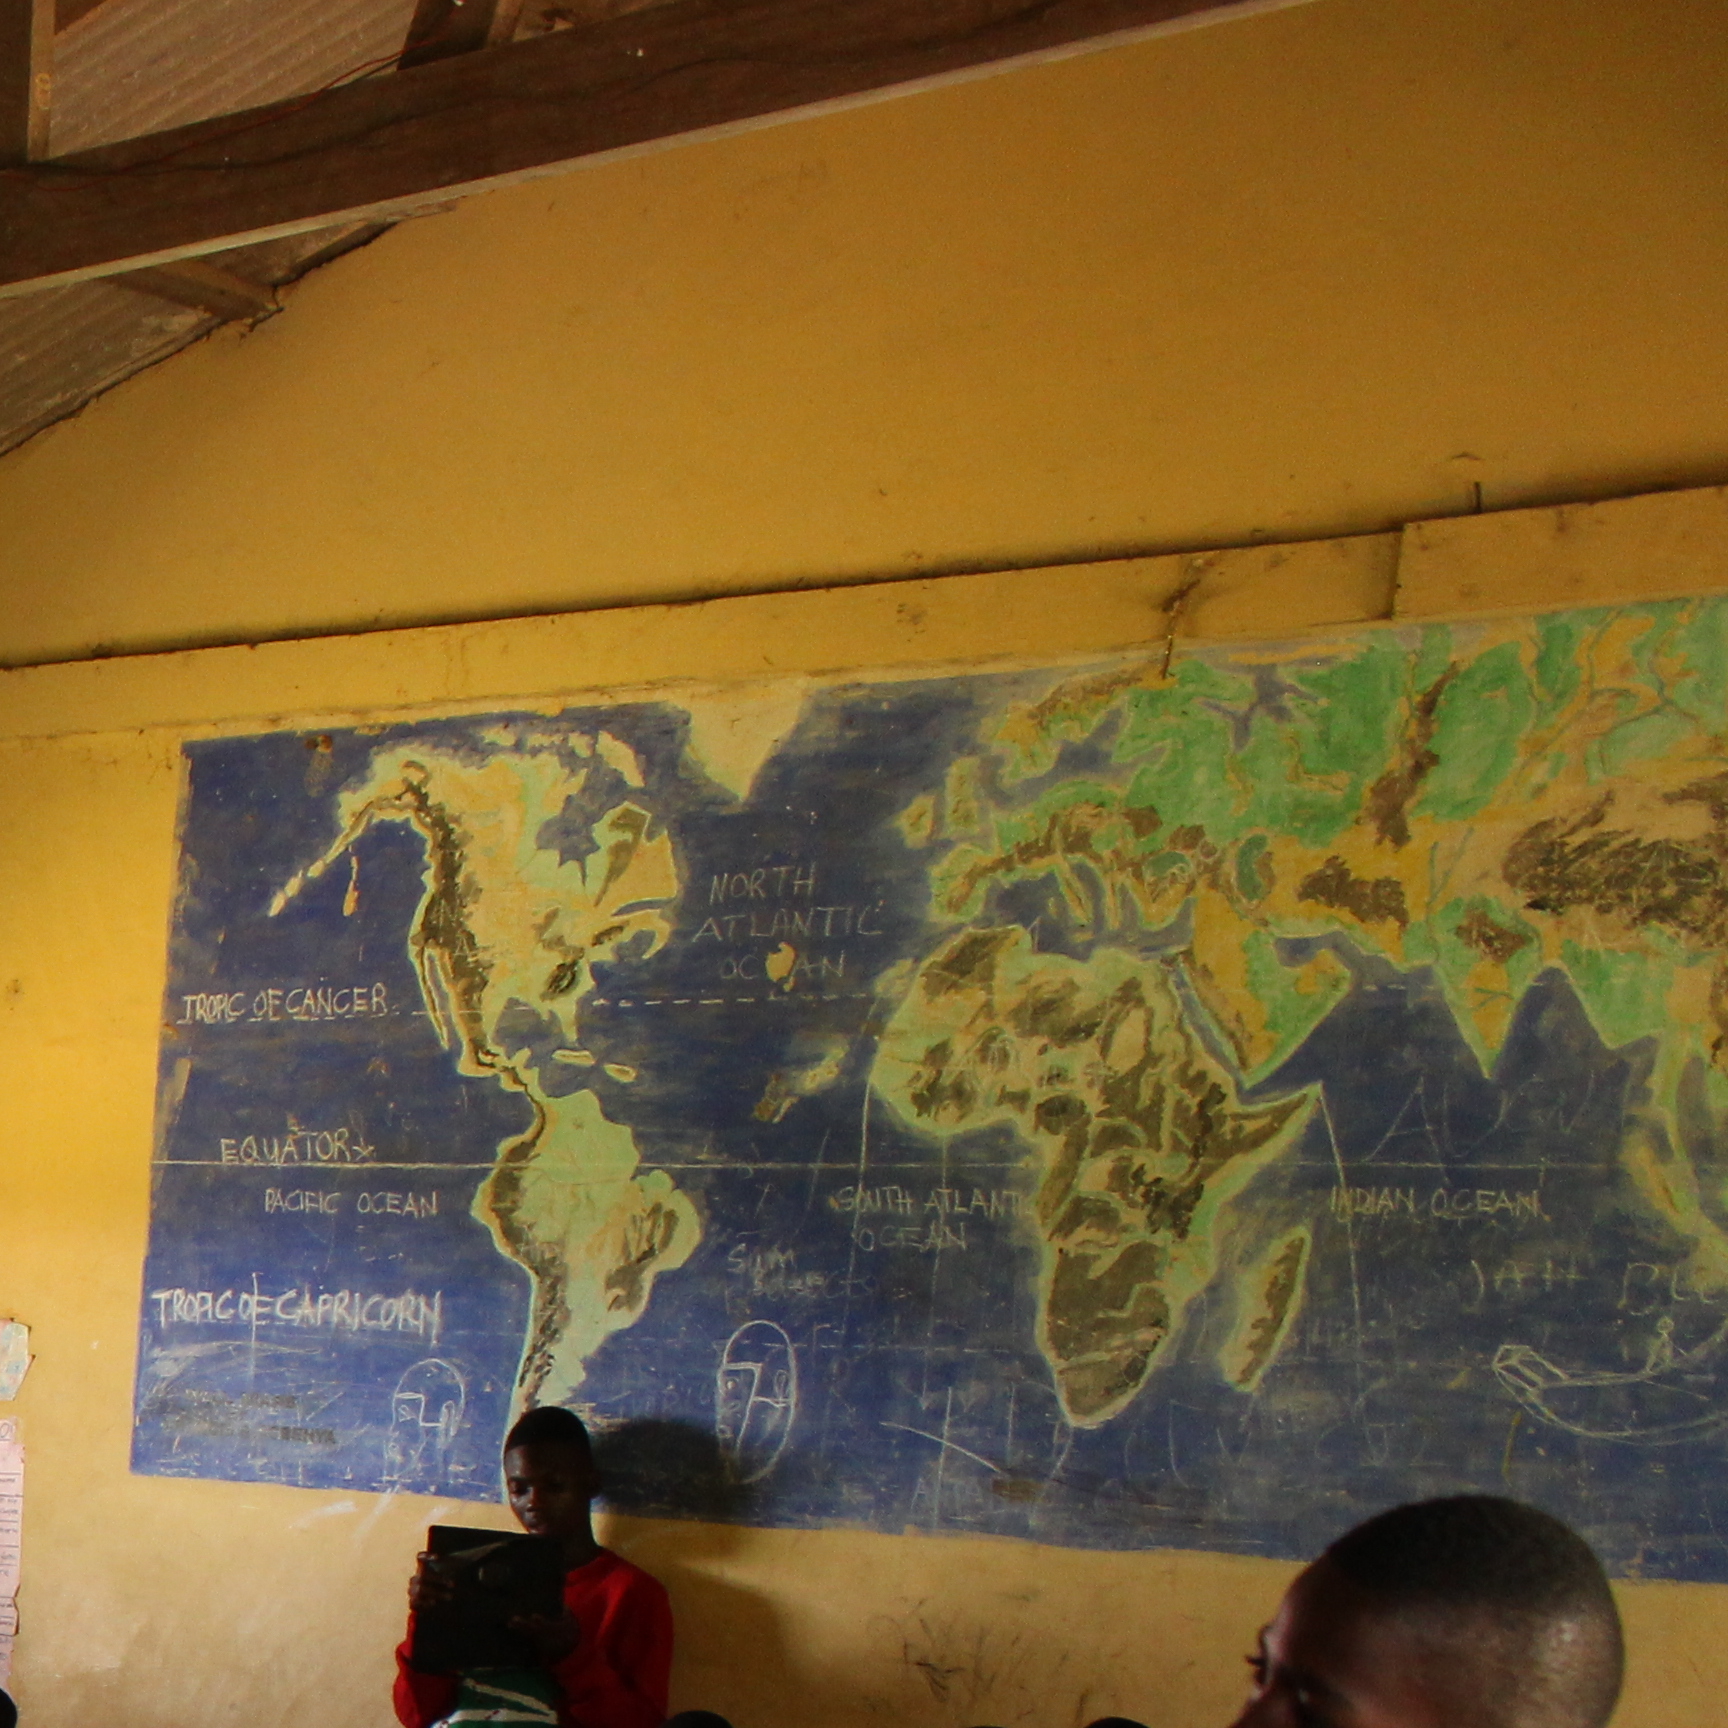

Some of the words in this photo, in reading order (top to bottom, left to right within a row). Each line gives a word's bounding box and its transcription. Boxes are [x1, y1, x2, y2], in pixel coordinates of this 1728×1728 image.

[709, 861, 817, 905] NORTH
[691, 900, 885, 942] ATLANTIC
[719, 949, 846, 980] OCAN
[176, 992, 245, 1024] TROPIC
[253, 988, 284, 1018] OF
[286, 982, 388, 1017] CANCER
[220, 1127, 351, 1164] EQUATOR
[264, 1187, 342, 1214] PACIFIC
[357, 1190, 441, 1219] OCEAN
[835, 1186, 913, 1215] SOUTH
[1330, 1185, 1415, 1217] INDIAN
[1431, 1187, 1539, 1218] OCEAN
[857, 1221, 968, 1251] OCEAN
[151, 1287, 236, 1329] TROPIC
[275, 1287, 443, 1341] CAPRICORN
